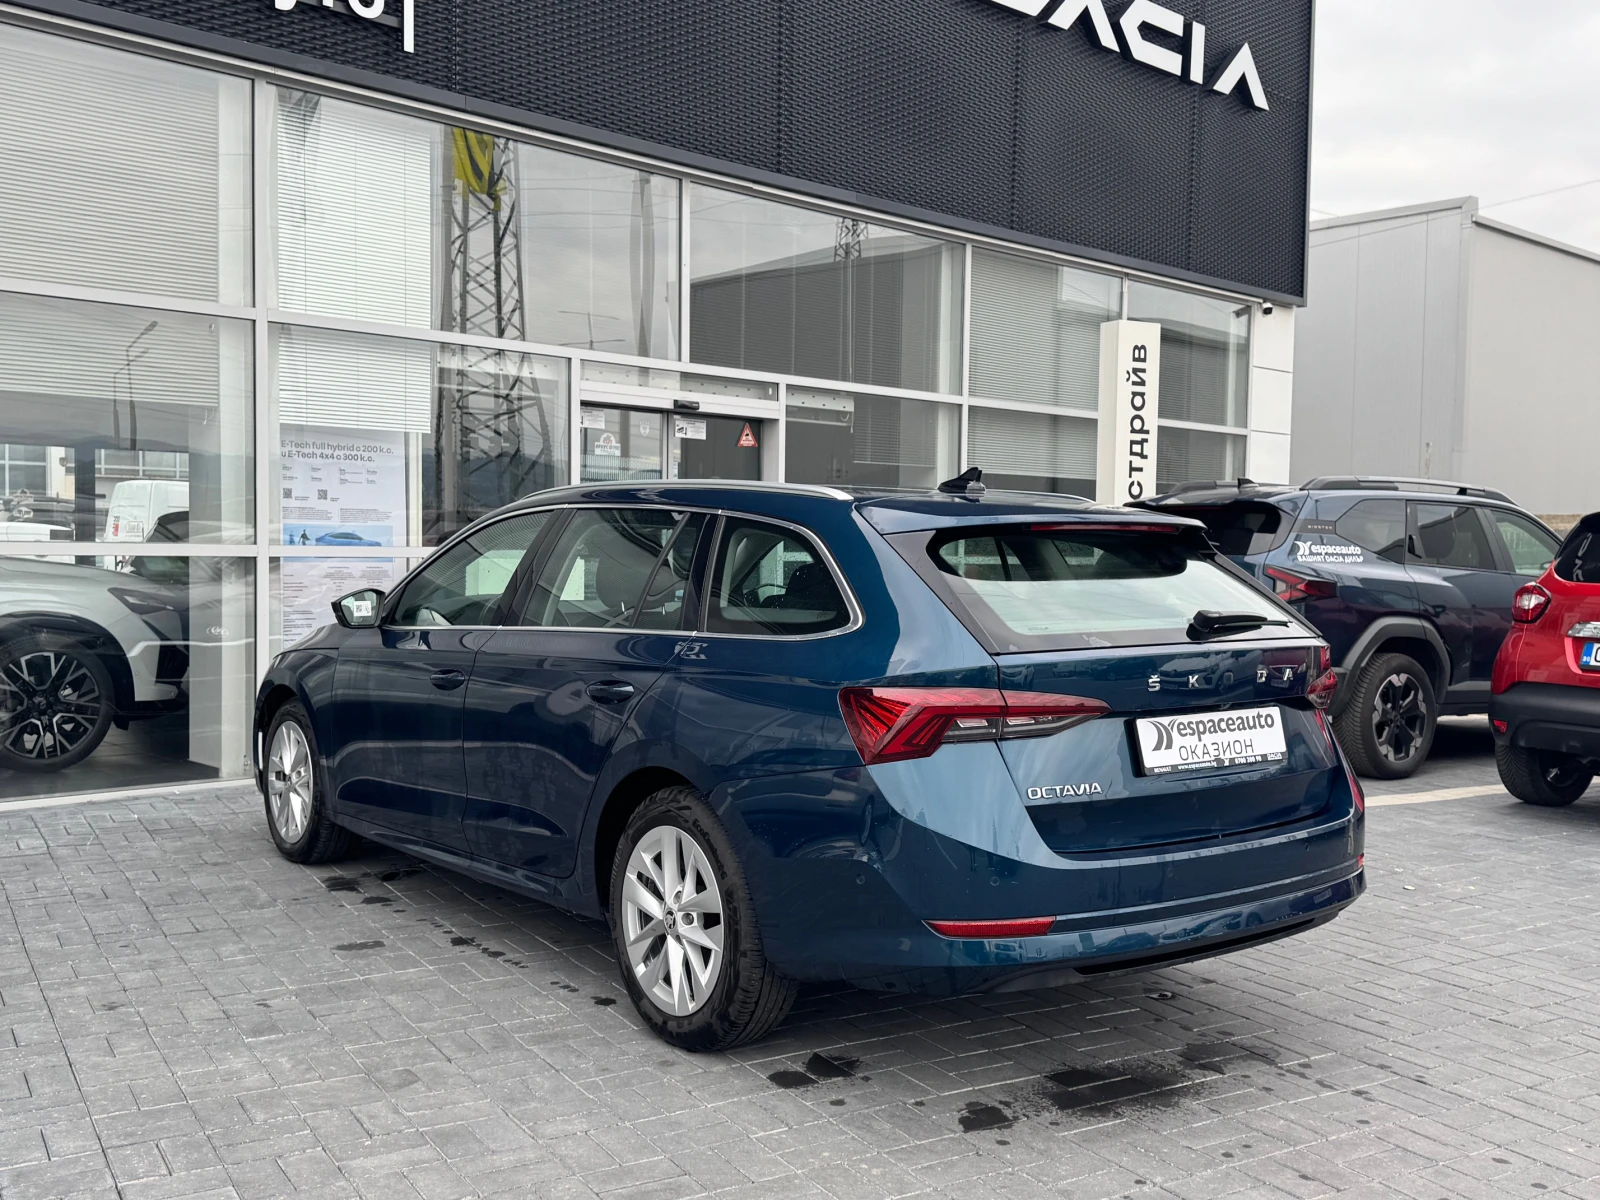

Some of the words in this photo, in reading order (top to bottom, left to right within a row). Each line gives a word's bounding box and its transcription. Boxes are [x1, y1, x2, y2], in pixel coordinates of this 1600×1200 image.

[990, 0, 1270, 111] ACIA
[281, 440, 311, 450] E-Tech
[312, 441, 326, 451] full
[327, 442, 355, 453] hybrid
[362, 445, 378, 453] 200
[287, 450, 318, 460] E-Tech
[342, 453, 359, 462] 300
[1311, 544, 1361, 556] espaceauto
[1176, 711, 1275, 742] espaceauto
[1178, 738, 1254, 761] ОКАЗИОН
[1027, 782, 1103, 800] OCTAVIA
